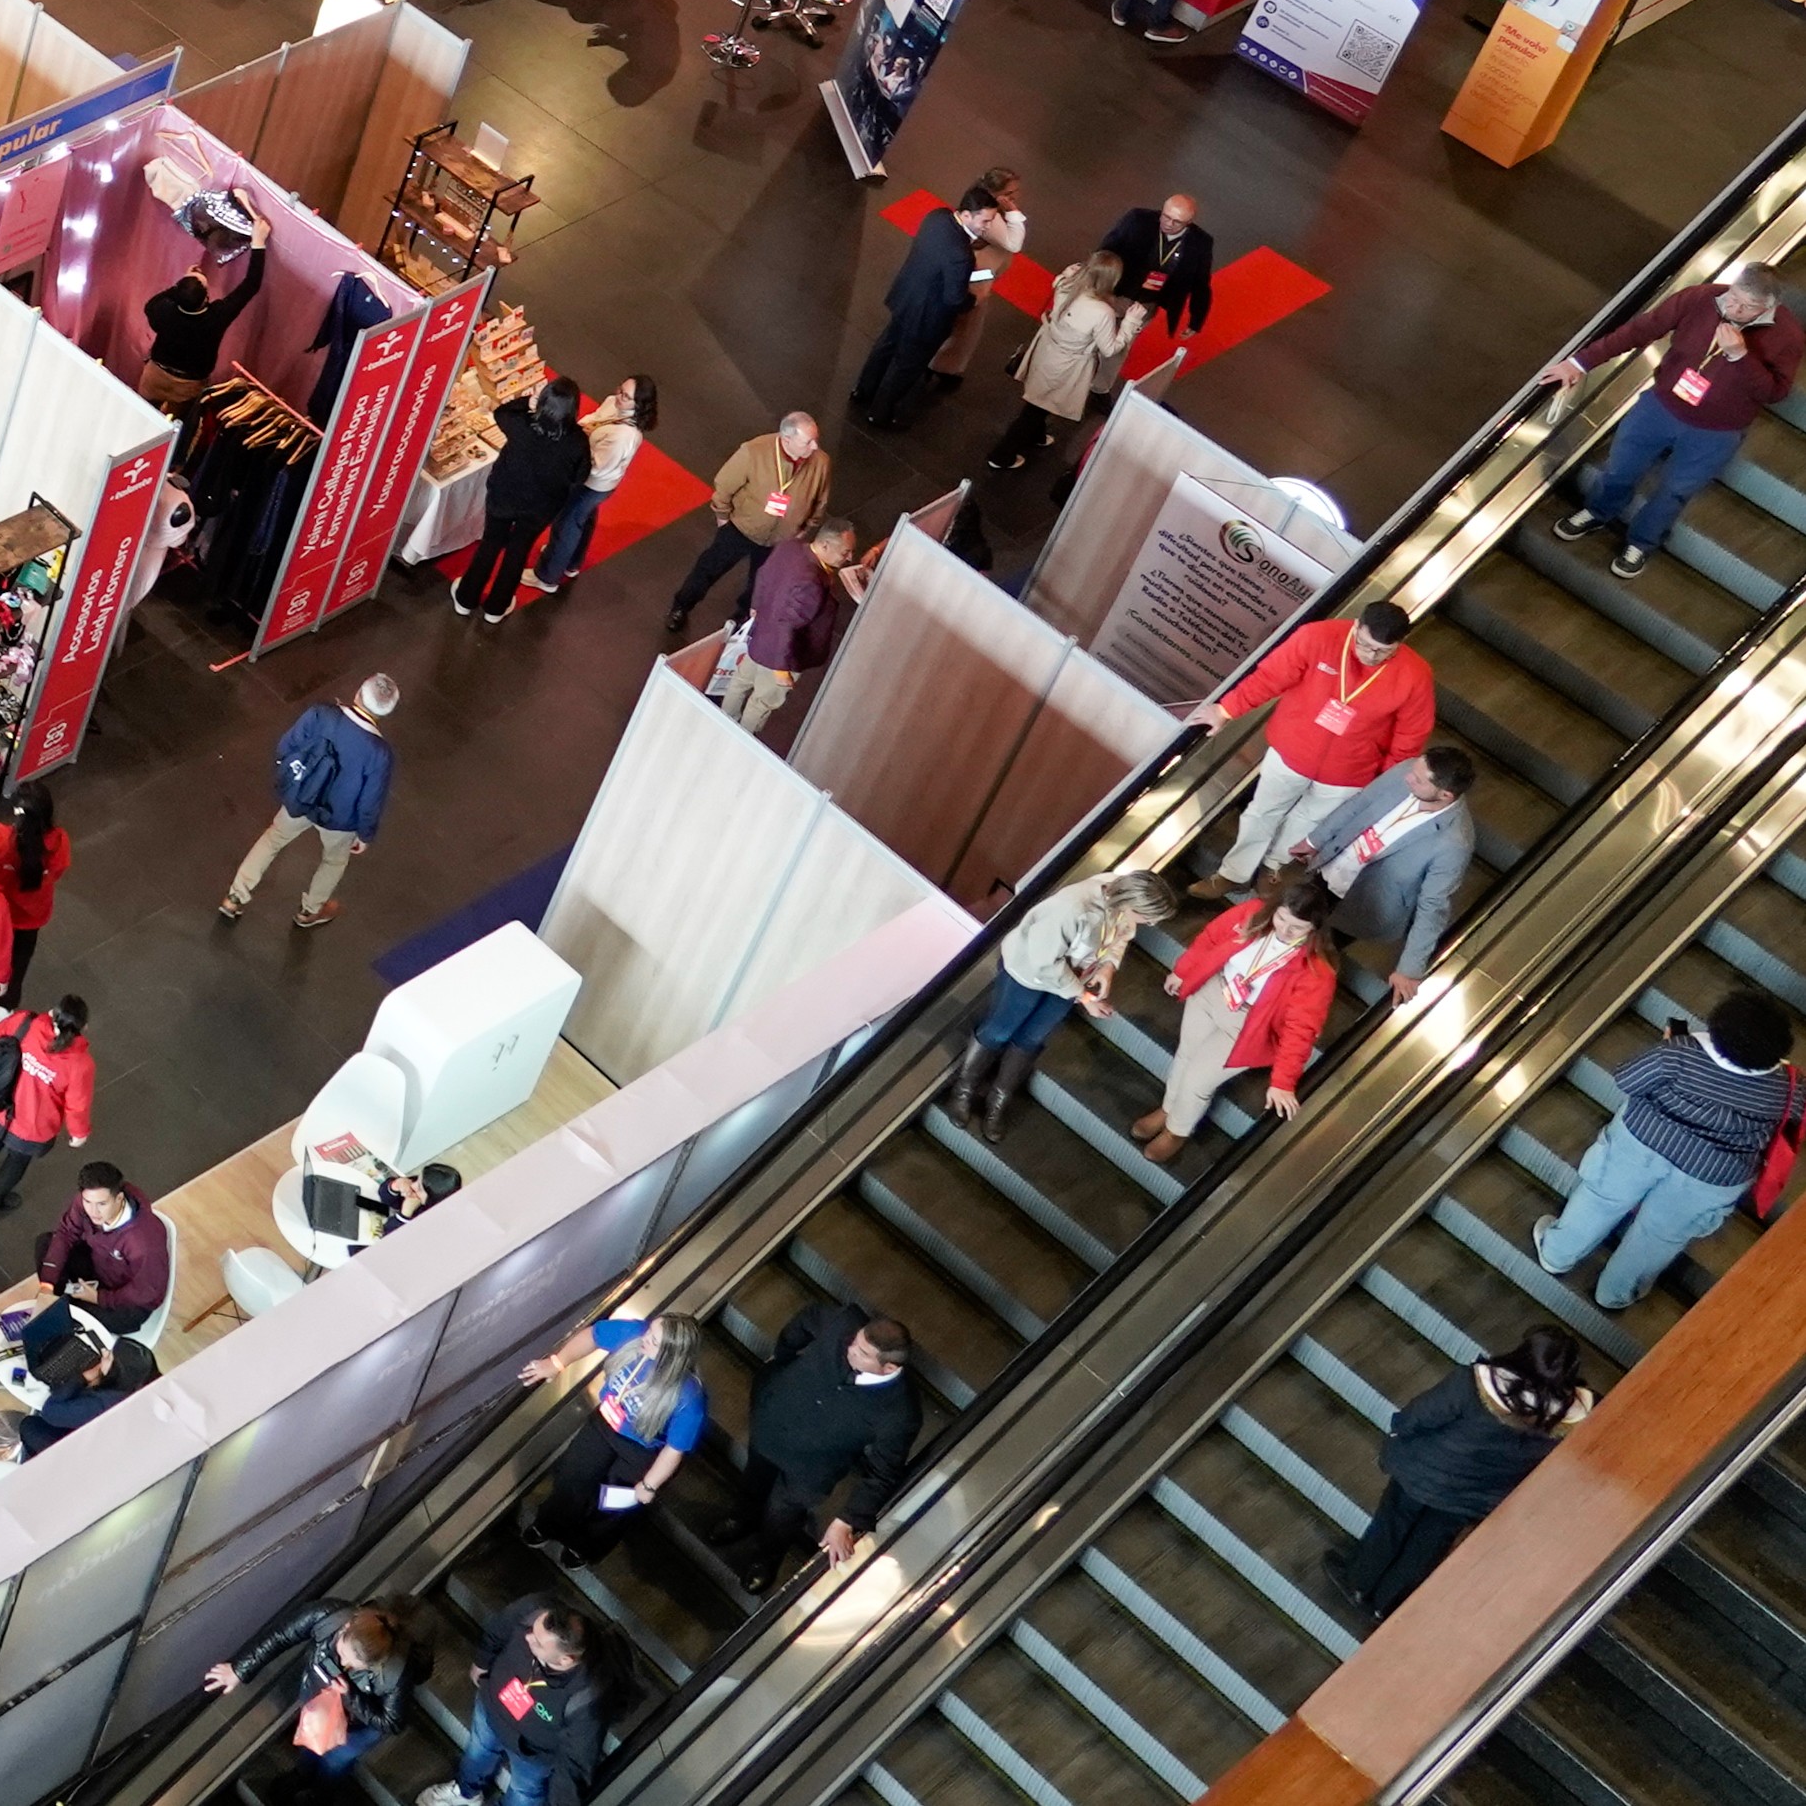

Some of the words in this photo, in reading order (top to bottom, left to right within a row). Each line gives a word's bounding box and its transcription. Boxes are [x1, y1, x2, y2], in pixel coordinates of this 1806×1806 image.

[341, 395, 369, 441] Ropa
[351, 385, 390, 467] Exclusiva
[61, 569, 103, 663] Accesorios
[84, 608, 110, 654] Leidy
[98, 536, 132, 610] Romero
